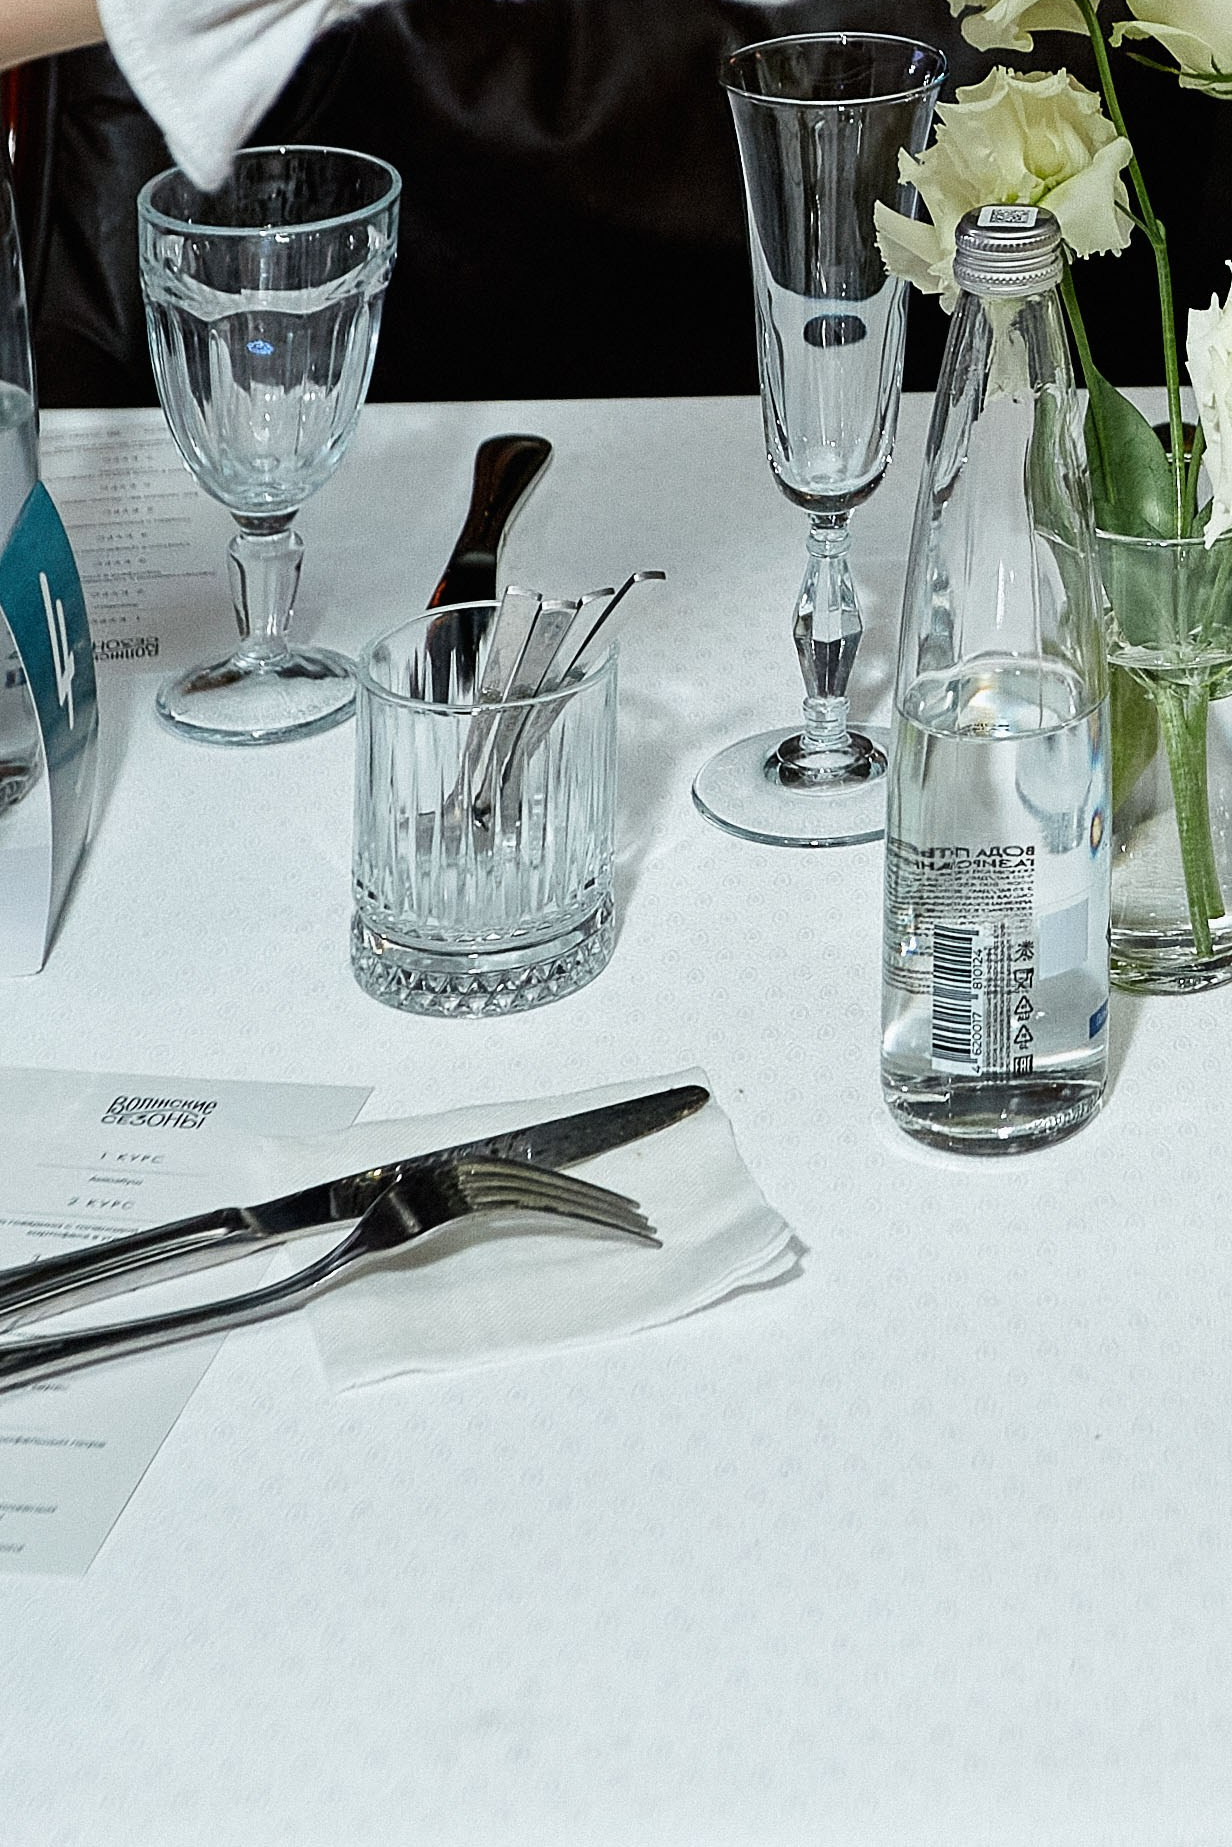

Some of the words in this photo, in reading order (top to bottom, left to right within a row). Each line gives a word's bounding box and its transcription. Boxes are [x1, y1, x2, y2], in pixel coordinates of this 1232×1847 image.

[972, 948, 983, 990] 810124
[972, 1011, 982, 1056] 620017
[972, 1065, 981, 1074] 4
[101, 1112, 207, 1130] СЕЗОНЫ
[116, 1153, 165, 1164] КУРС
[85, 1198, 136, 1210] КУРС
